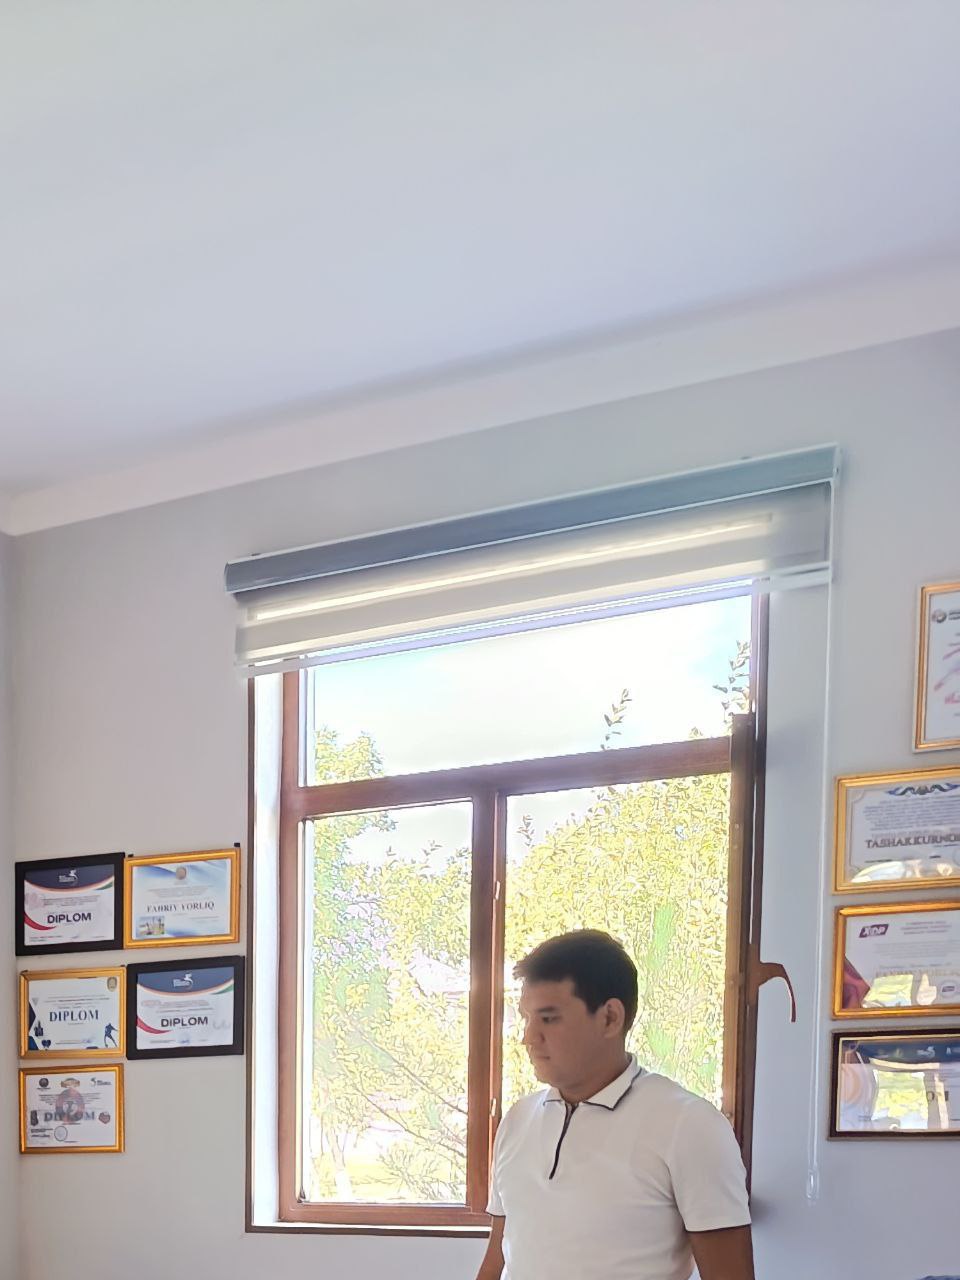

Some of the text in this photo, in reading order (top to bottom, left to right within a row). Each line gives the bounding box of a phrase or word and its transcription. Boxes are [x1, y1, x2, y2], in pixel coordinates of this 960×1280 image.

[47, 912, 92, 925] DIPLOM
[49, 1009, 99, 1022] DIPLOM
[160, 1016, 209, 1028] DIPLOM
